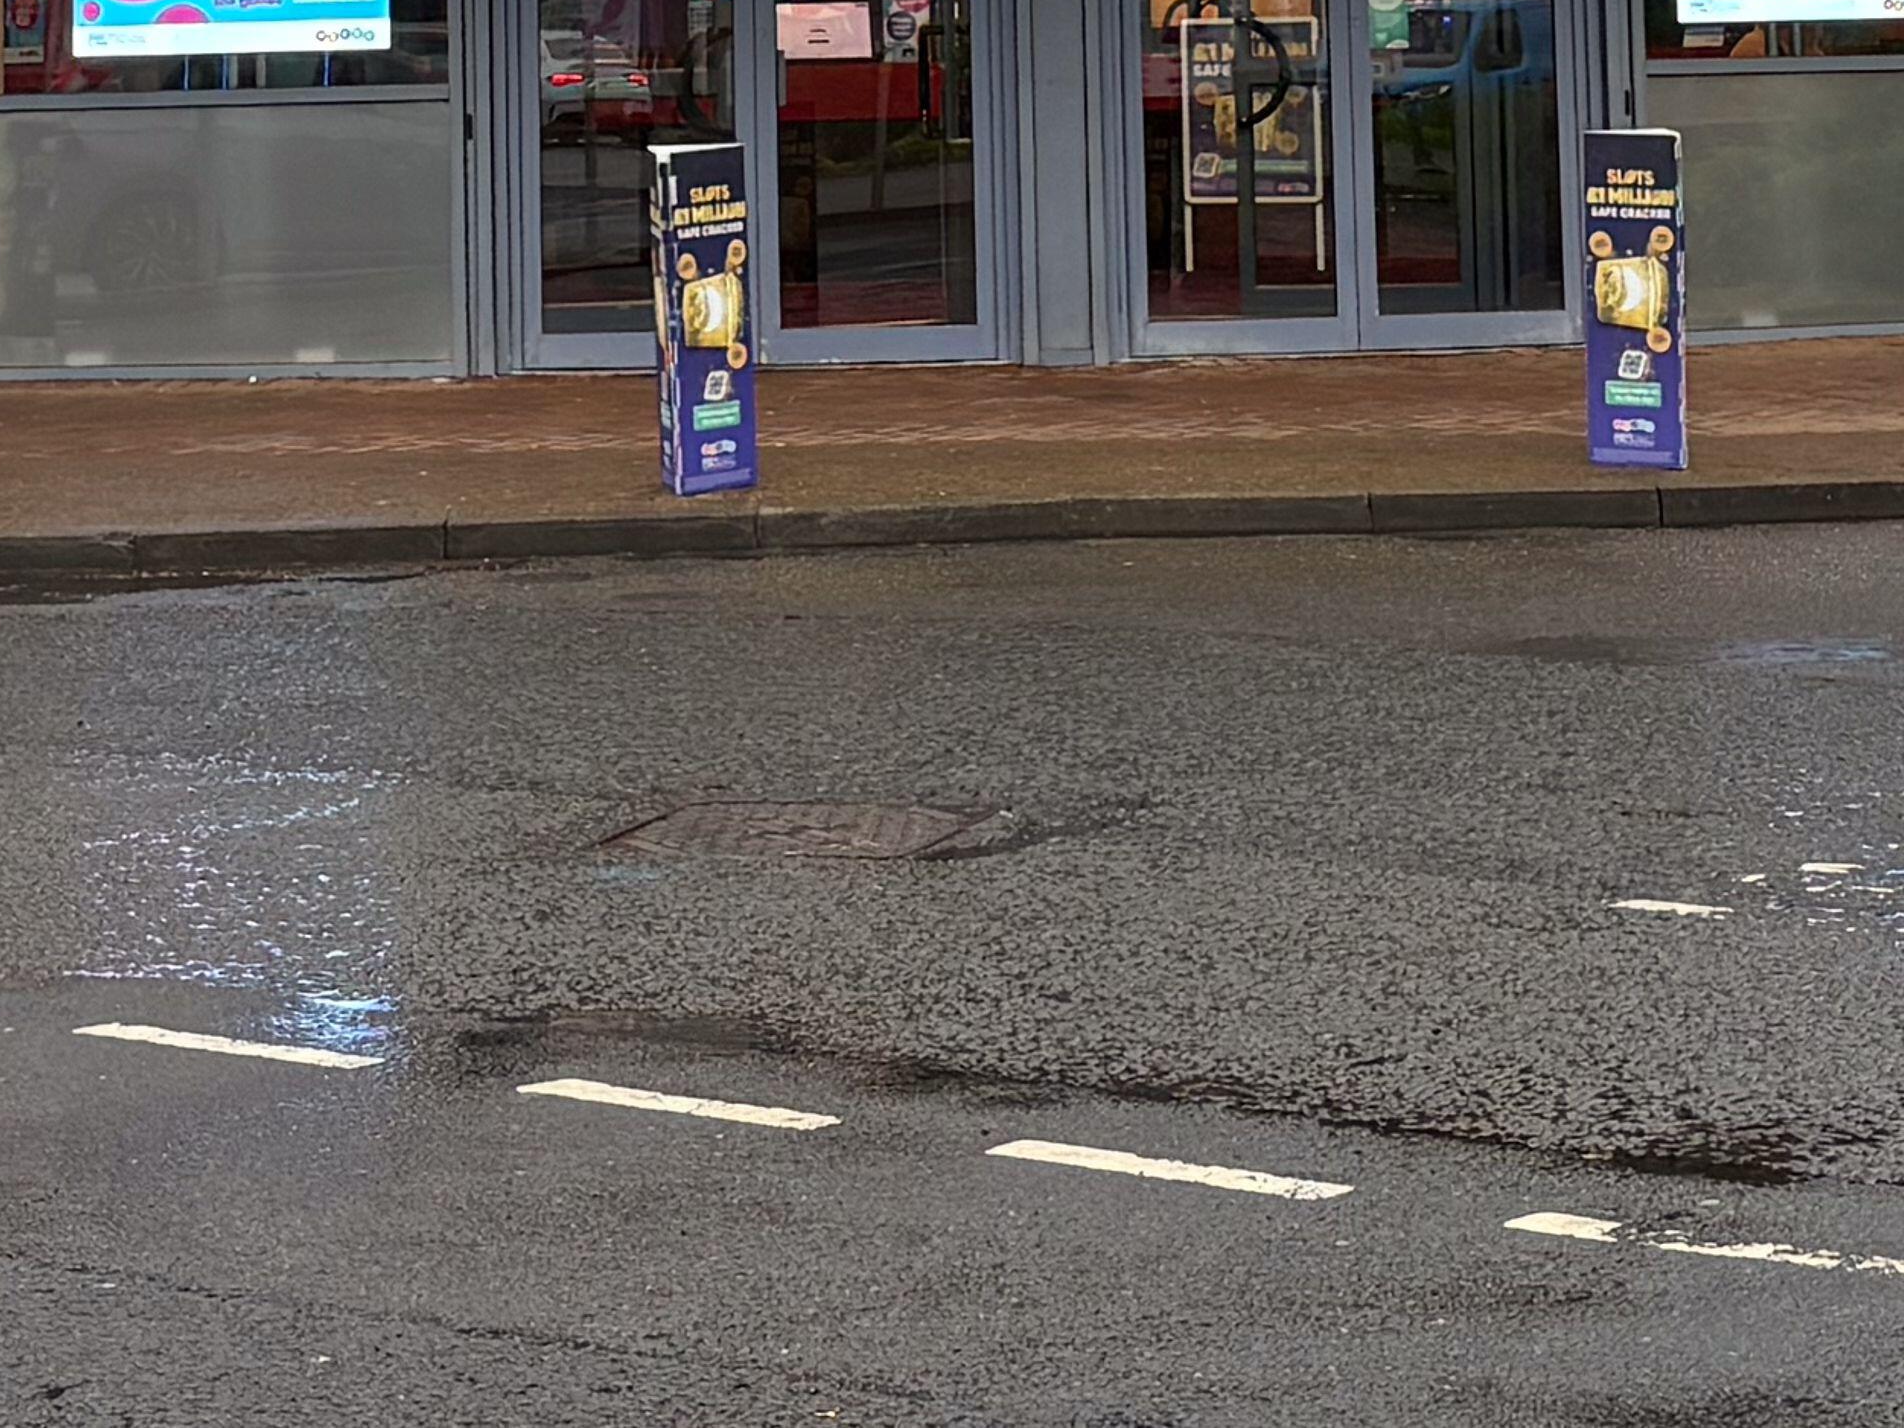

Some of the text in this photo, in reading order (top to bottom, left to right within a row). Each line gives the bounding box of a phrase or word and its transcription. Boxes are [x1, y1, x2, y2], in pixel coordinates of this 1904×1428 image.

[1606, 168, 1656, 186] SLOTS
[689, 184, 731, 205] SLOTS
[1607, 186, 1675, 207] MILLION
